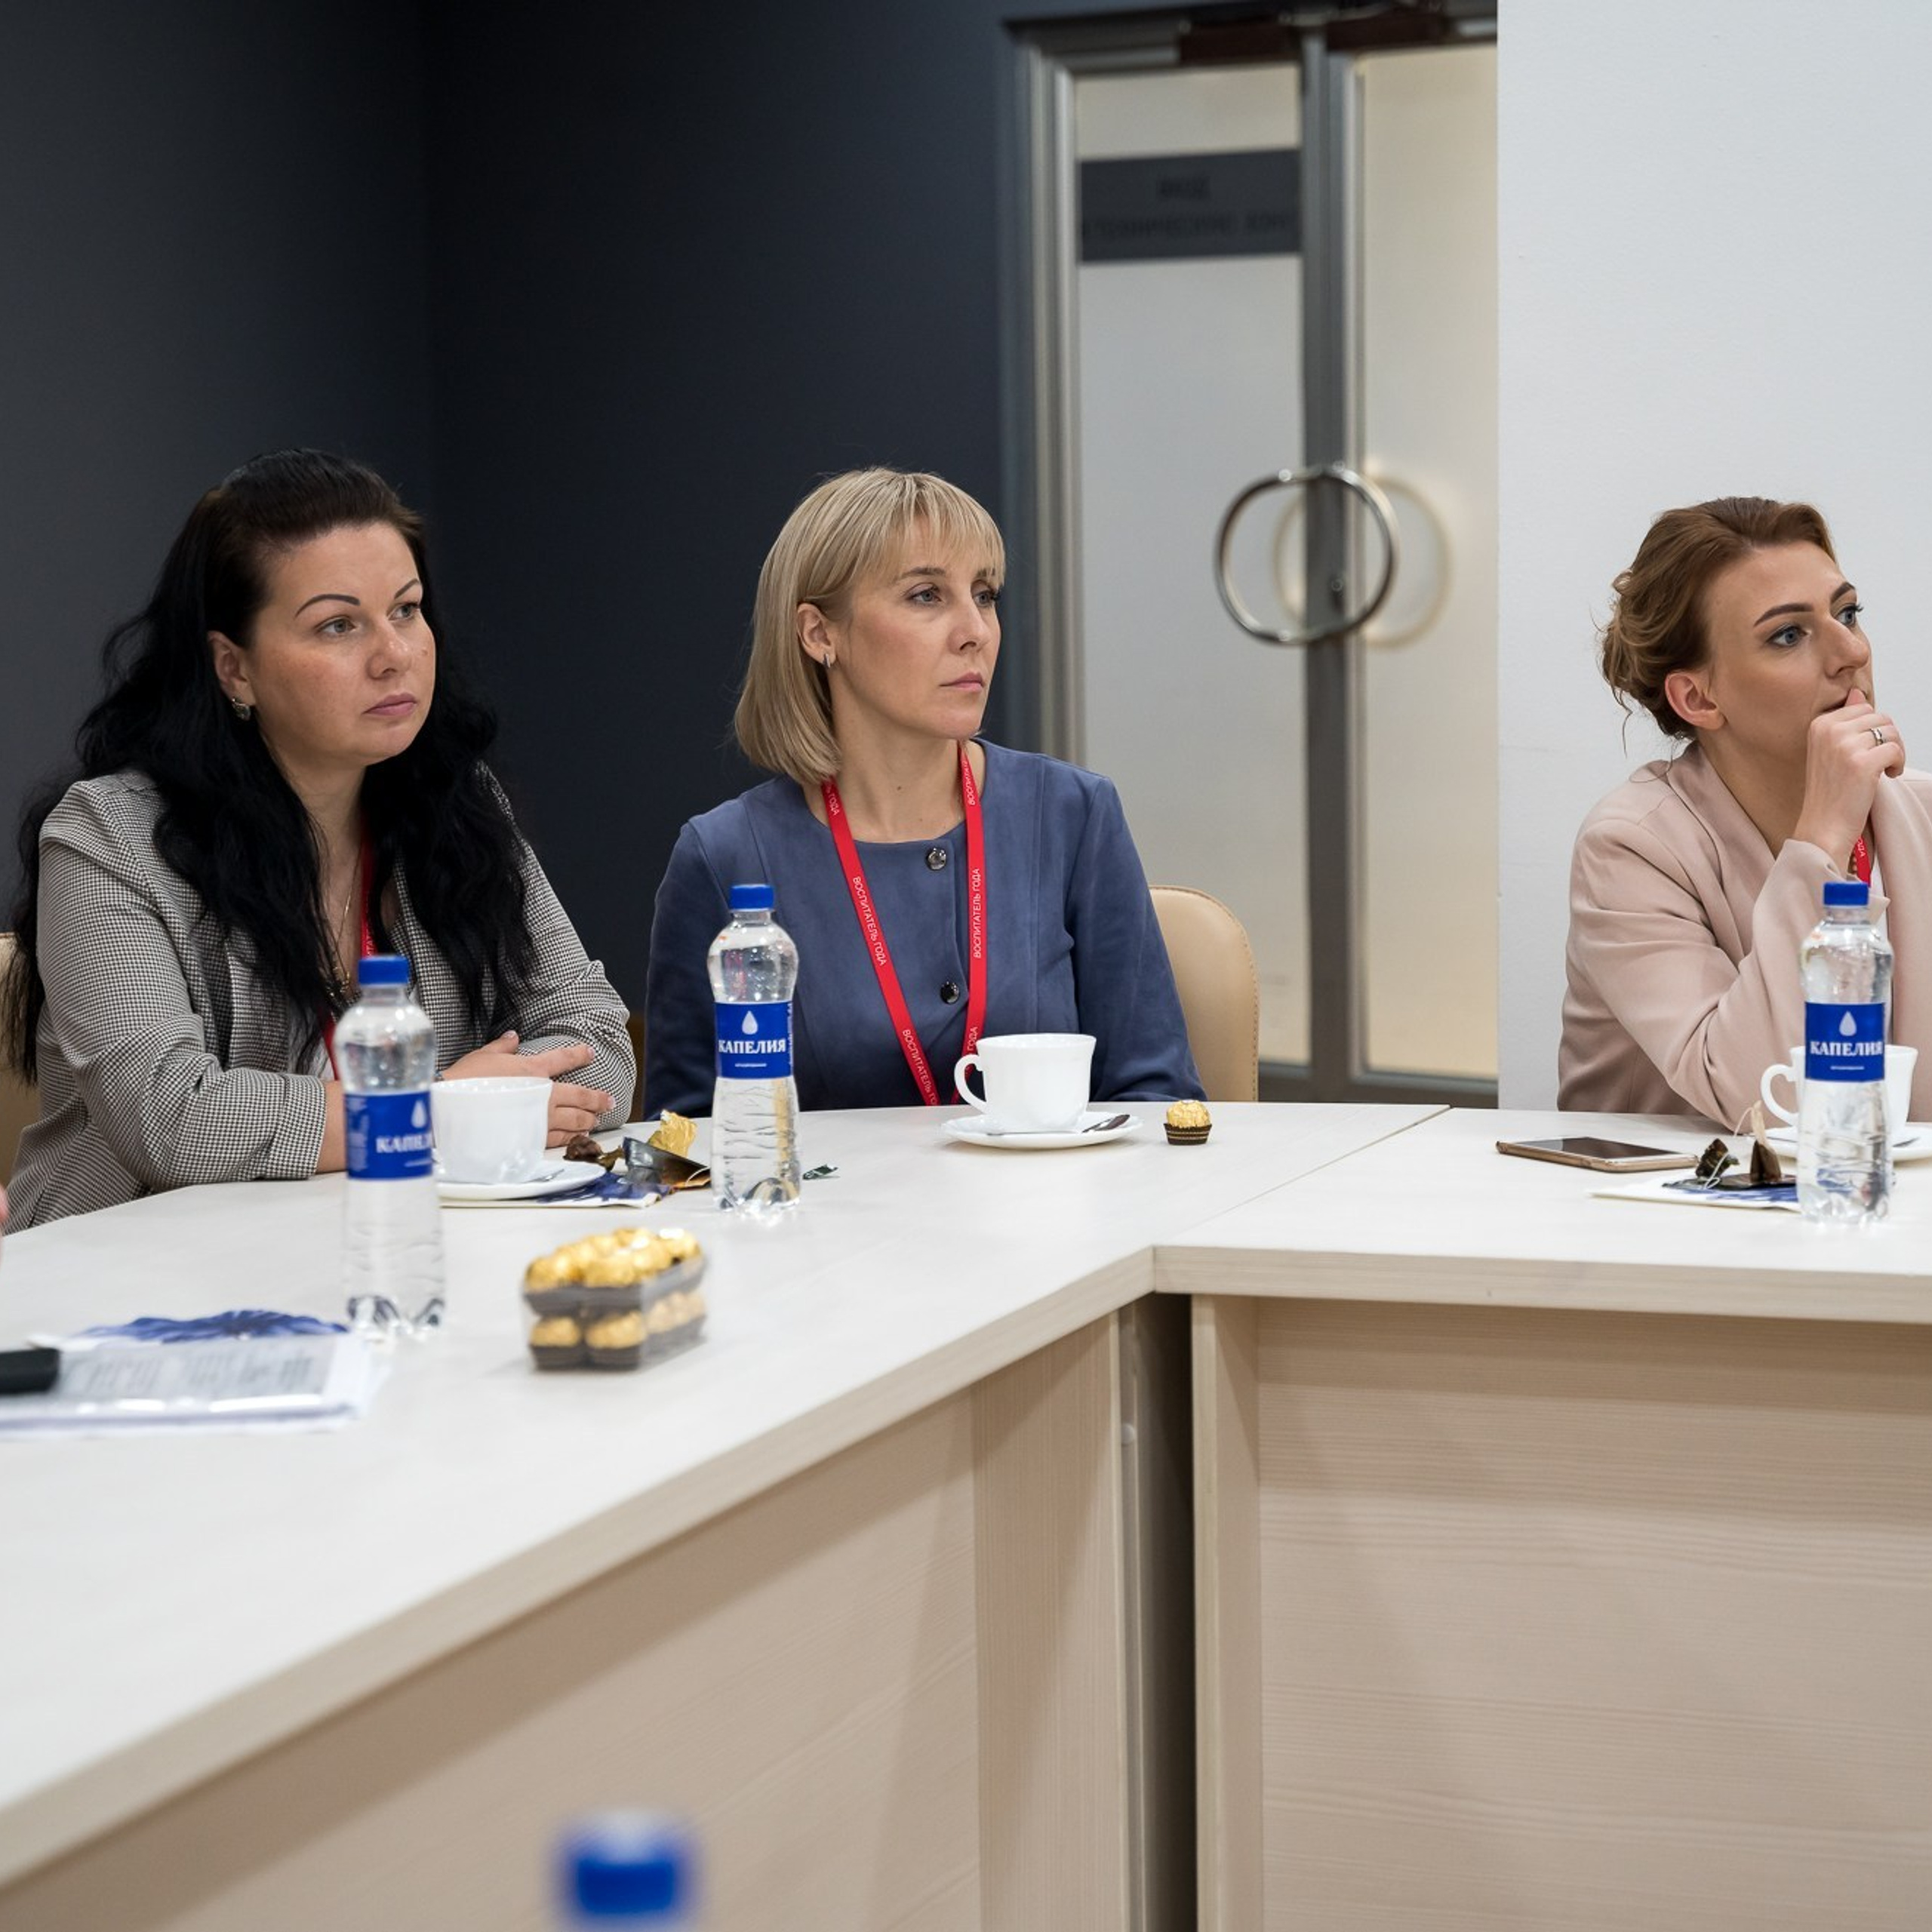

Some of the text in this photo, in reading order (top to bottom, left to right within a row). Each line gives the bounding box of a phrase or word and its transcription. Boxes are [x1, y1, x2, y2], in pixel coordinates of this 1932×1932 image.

[853, 876, 887, 966] ВОСПИТАТЕЛЬ ГОДА
[971, 868, 982, 958] ВОСПИТАТЕЛЬ ГОДА
[718, 1038, 786, 1054] КАПЕЛИЯ
[967, 1026, 979, 1051] ГОДА
[1810, 1040, 1884, 1057] КАПЕЛИЯ
[903, 1029, 932, 1094] ВОСПИТАТЕЛЬ
